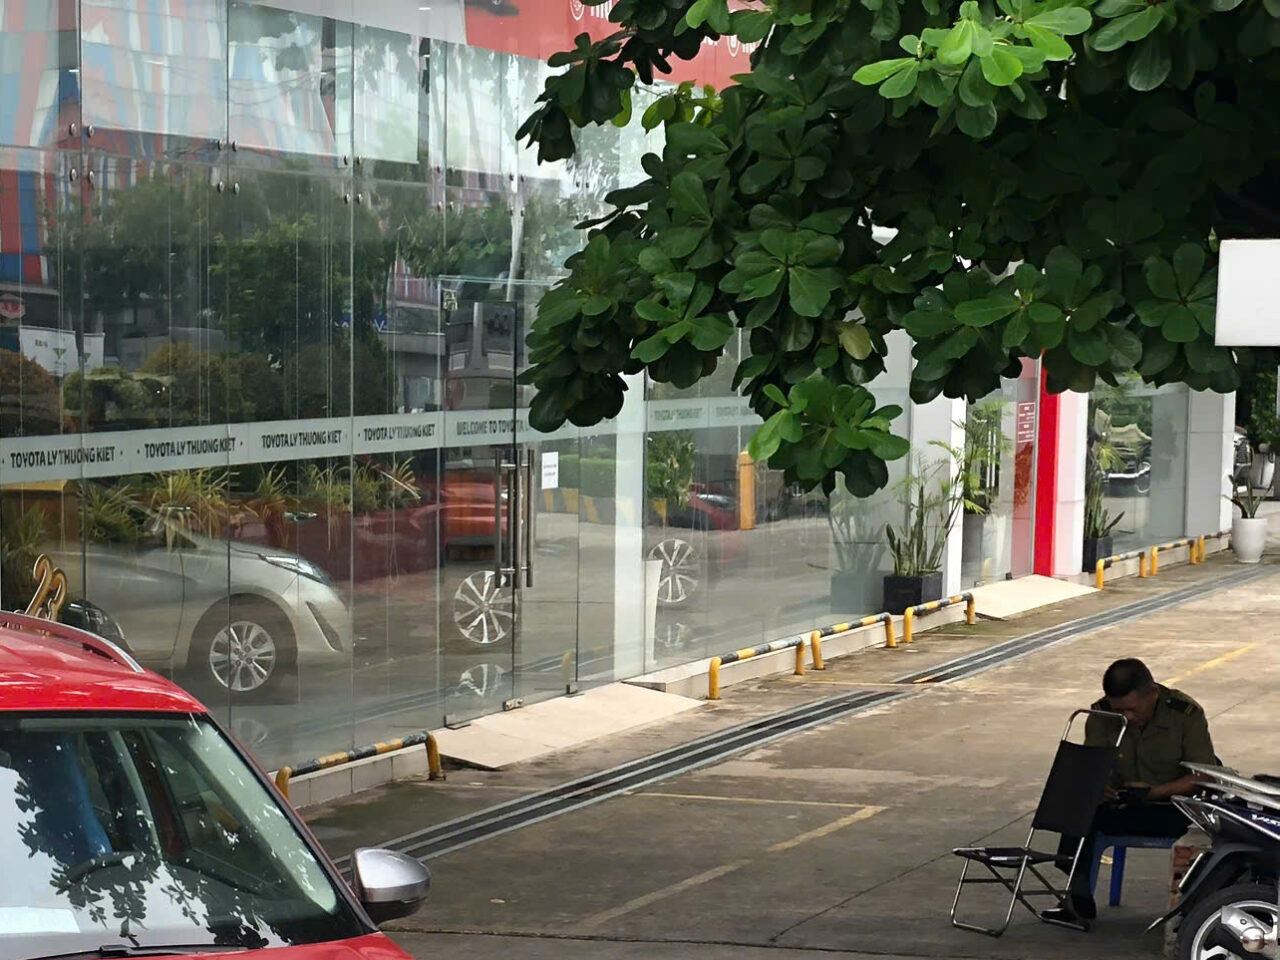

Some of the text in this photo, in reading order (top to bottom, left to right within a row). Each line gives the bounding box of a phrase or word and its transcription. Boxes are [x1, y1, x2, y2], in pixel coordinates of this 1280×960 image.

[363, 426, 388, 441] TOYOTA
[388, 426, 396, 440] LY
[422, 423, 436, 437] KIET
[456, 420, 488, 435] WELCOME
[489, 420, 498, 434] TO
[144, 437, 236, 459] TOYOTA LY THUONG KIET
[261, 430, 342, 449] TOYOTA LY THUONG KIET
[10, 445, 116, 468] TOYOTA LY THUONG KIET
